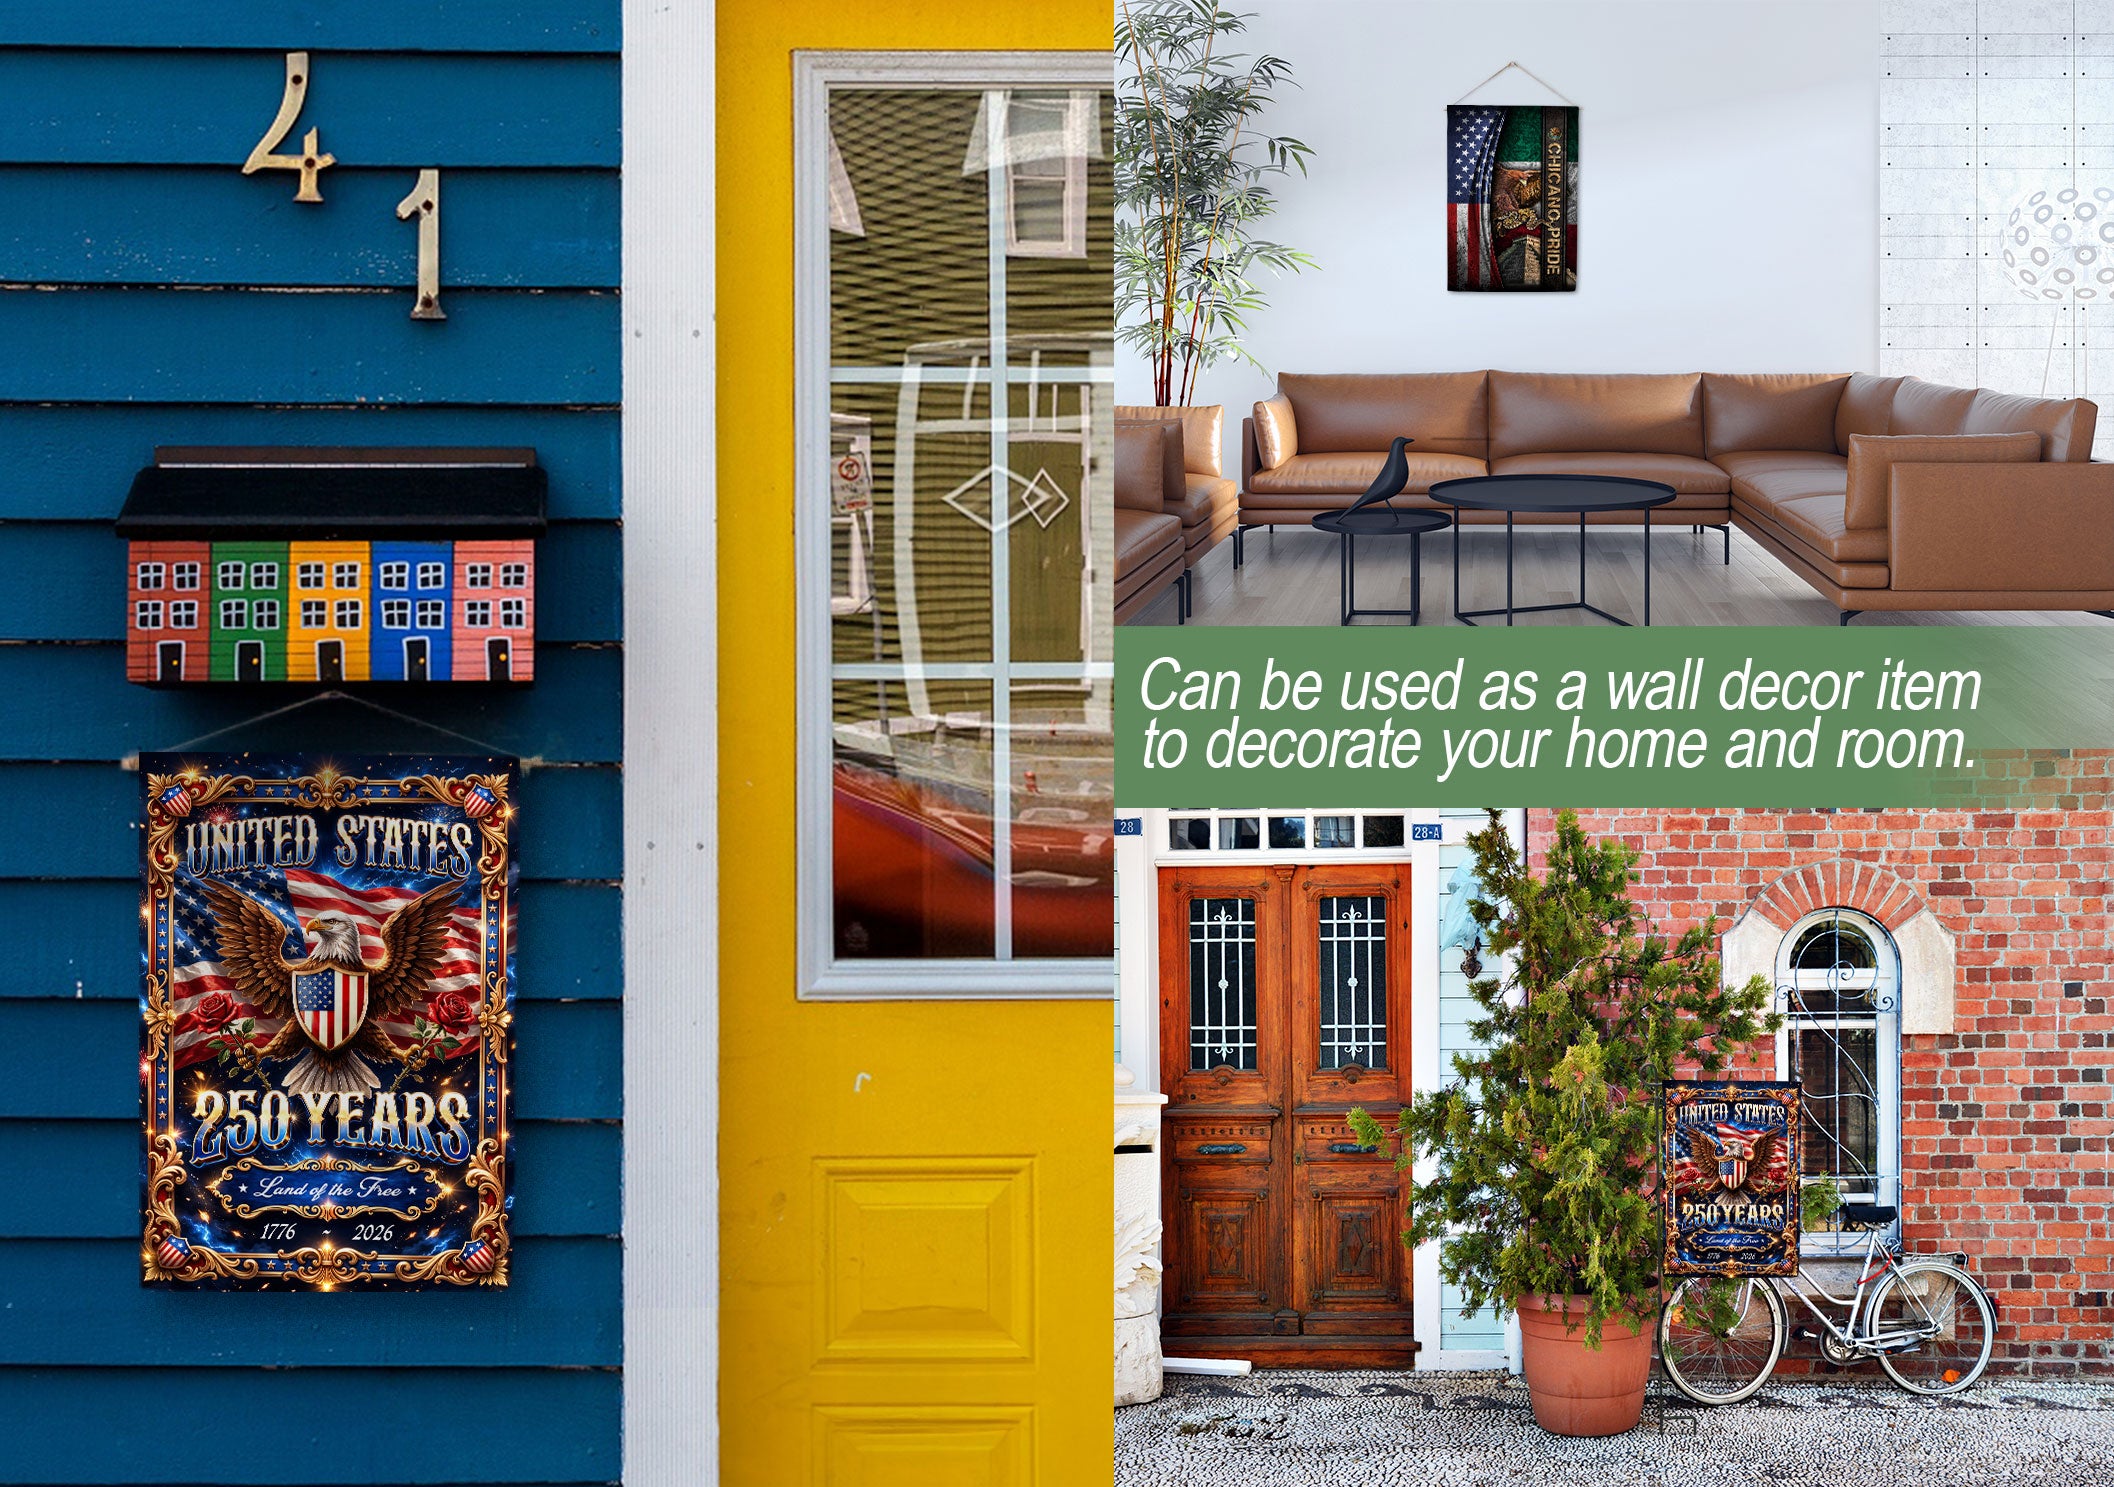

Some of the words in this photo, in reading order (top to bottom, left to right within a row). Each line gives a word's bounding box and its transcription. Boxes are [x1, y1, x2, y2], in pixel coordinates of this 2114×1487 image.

[1547, 143, 1562, 220] CHICANO
[1546, 227, 1561, 275] PRIDE
[1120, 820, 1134, 834] 28
[1414, 826, 1440, 840] 28-A
[185, 814, 319, 878] UNITED
[335, 814, 472, 879] STATES
[191, 1090, 292, 1165] 250
[297, 1090, 471, 1165] YEARS
[1679, 1102, 1729, 1127] UNITED
[1734, 1102, 1785, 1127] STATES
[253, 1175, 309, 1197] Land
[309, 1183, 328, 1202] of
[327, 1183, 353, 1197] the
[356, 1176, 402, 1198] Free
[1681, 1203, 1717, 1231] 250
[1722, 1203, 1785, 1230] YEARS
[259, 1222, 297, 1241] 1776
[351, 1223, 394, 1242] 2026
[1740, 1252, 1756, 1260] 2026
